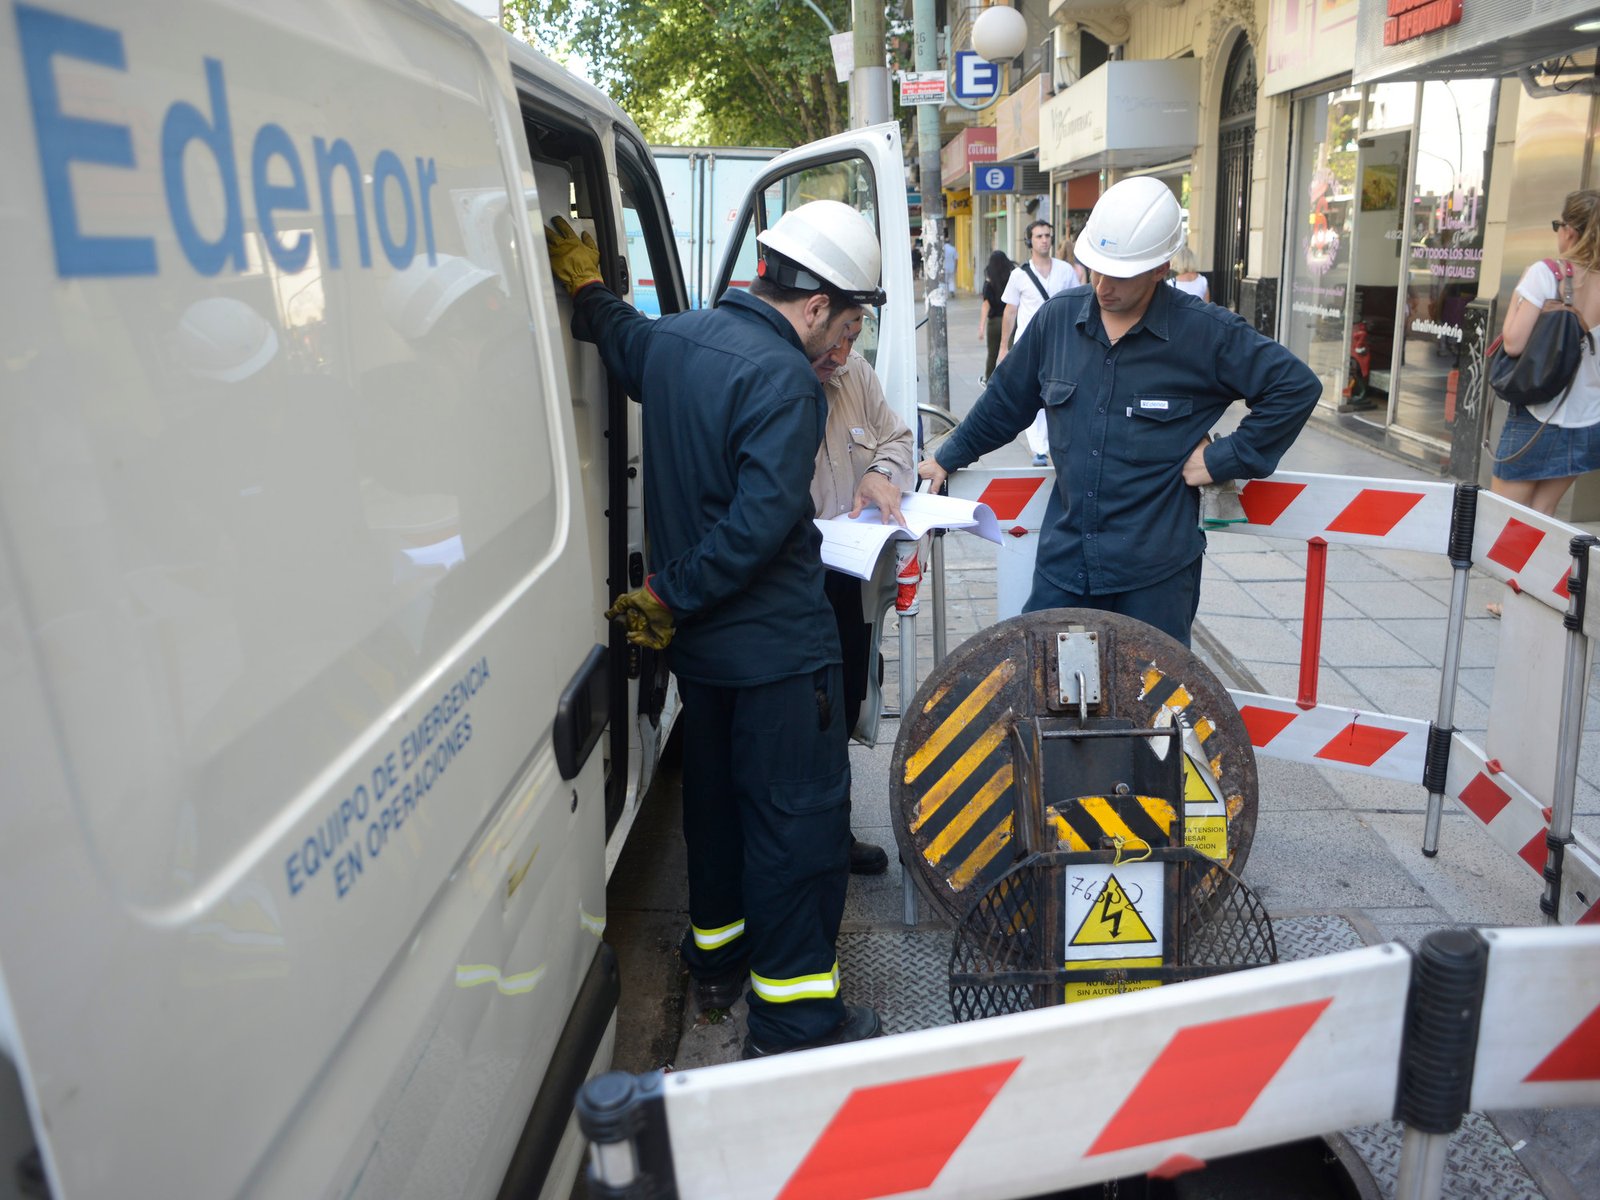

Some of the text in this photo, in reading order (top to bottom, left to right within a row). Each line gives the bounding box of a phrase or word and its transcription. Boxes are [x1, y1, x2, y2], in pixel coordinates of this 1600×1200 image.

[962, 55, 994, 95] E
[11, 2, 438, 278] Edenor
[990, 172, 1000, 185] E
[1425, 248, 1449, 259] TODOS
[1449, 249, 1463, 259] LOS
[1430, 264, 1476, 278] SON IGUALES
[284, 656, 491, 897] EQUIPO DE EMERGENCIA
[333, 713, 473, 899] EN OPERACIONES
